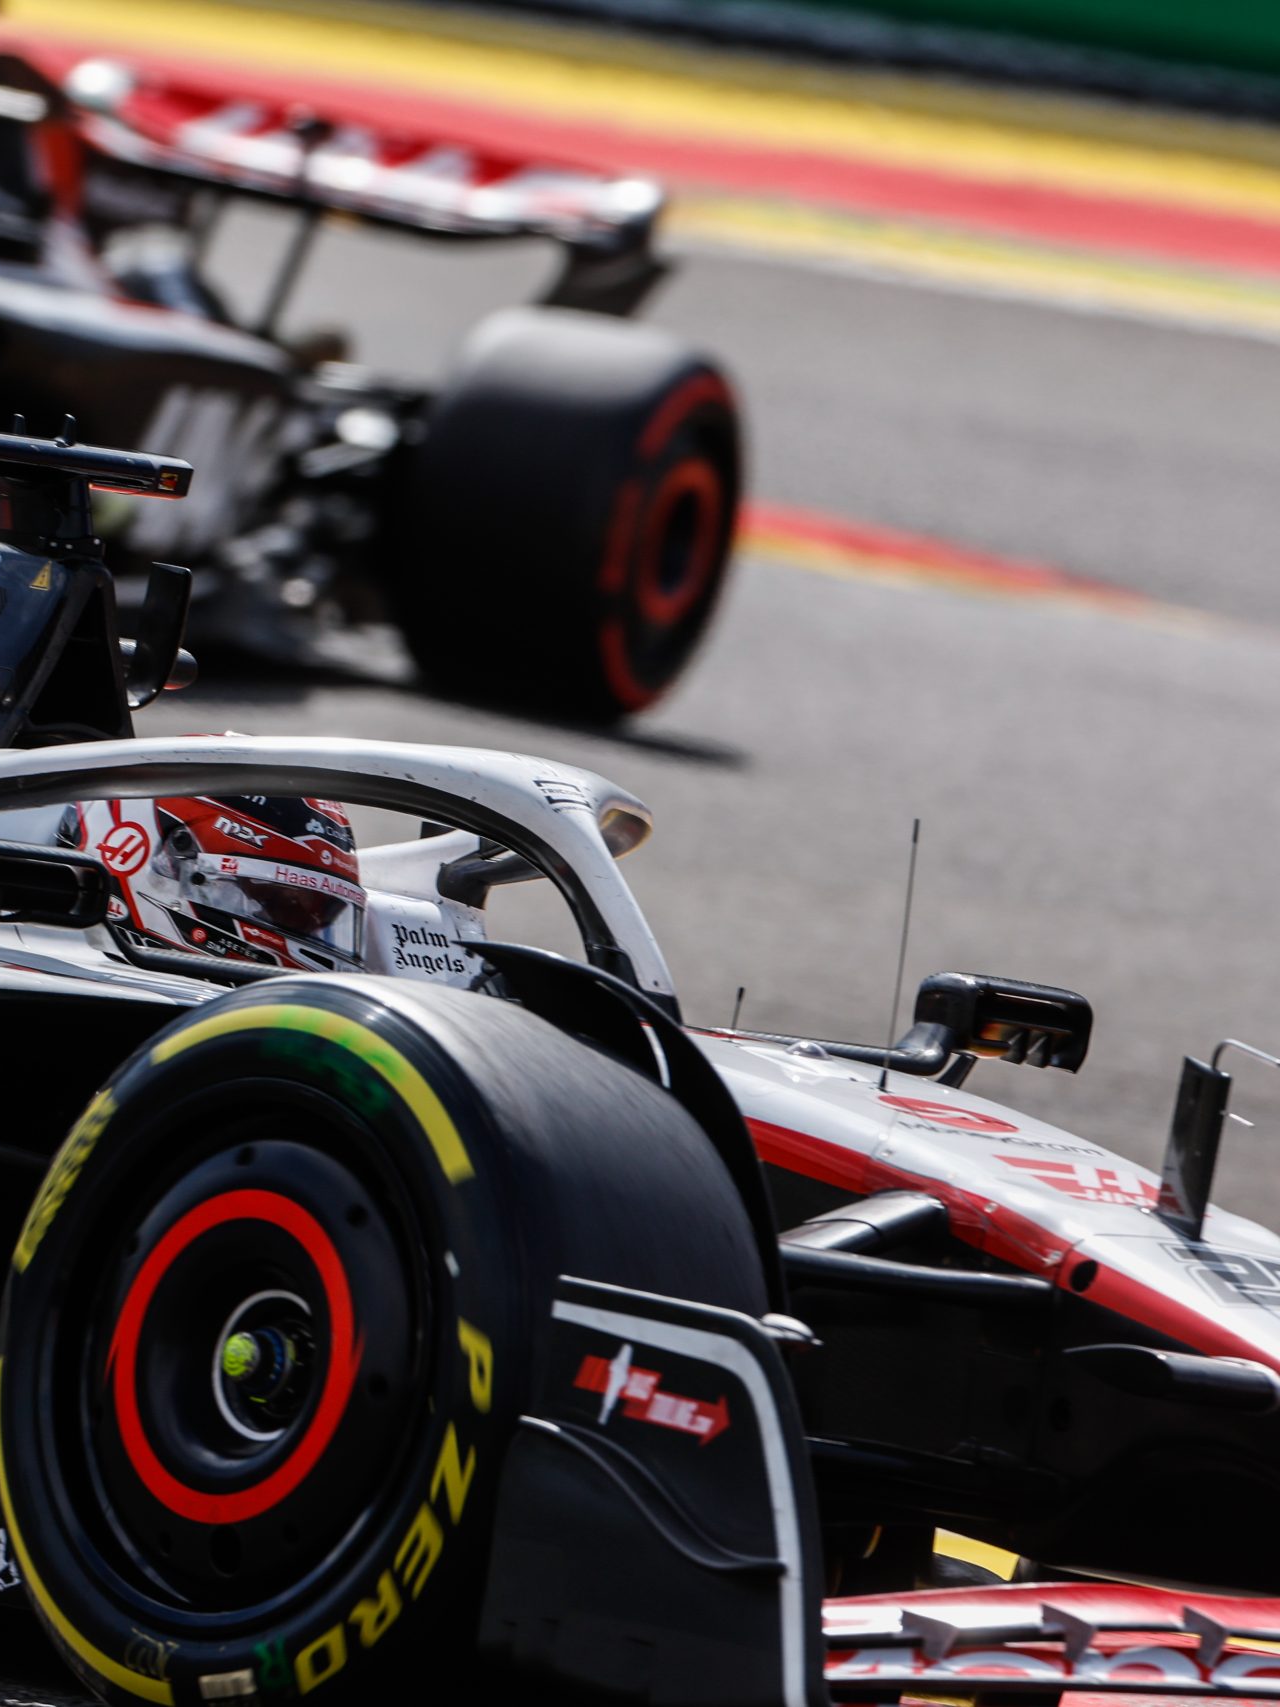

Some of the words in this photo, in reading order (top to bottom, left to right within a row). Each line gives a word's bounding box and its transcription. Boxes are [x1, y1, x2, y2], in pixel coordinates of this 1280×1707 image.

[275, 865, 317, 888] Haas
[391, 923, 450, 948] Palm
[392, 946, 465, 975] Angels
[457, 1315, 494, 1414] P
[294, 1420, 477, 1696] ZERO
